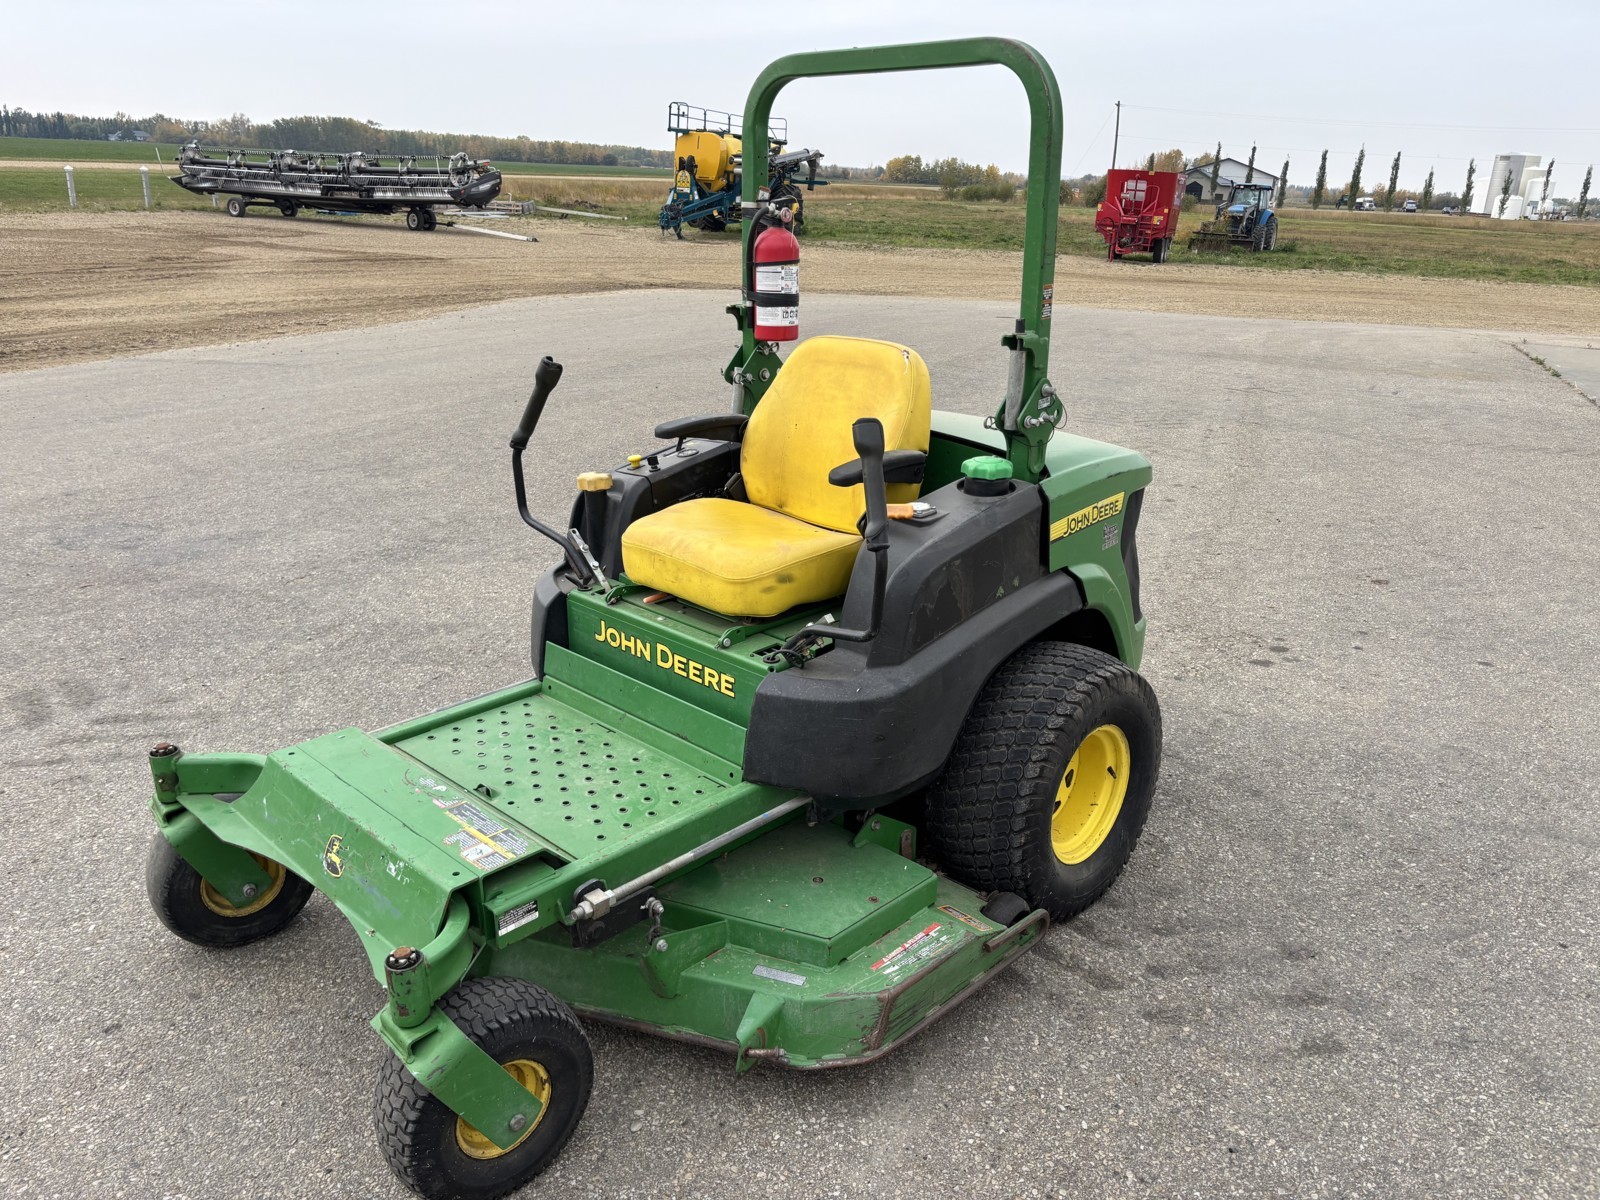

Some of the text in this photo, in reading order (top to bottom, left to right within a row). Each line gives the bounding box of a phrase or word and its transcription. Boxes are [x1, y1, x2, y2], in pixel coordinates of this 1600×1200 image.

[1063, 499, 1119, 536] JOHN DEERE
[594, 620, 736, 698] JOHN DEERE
